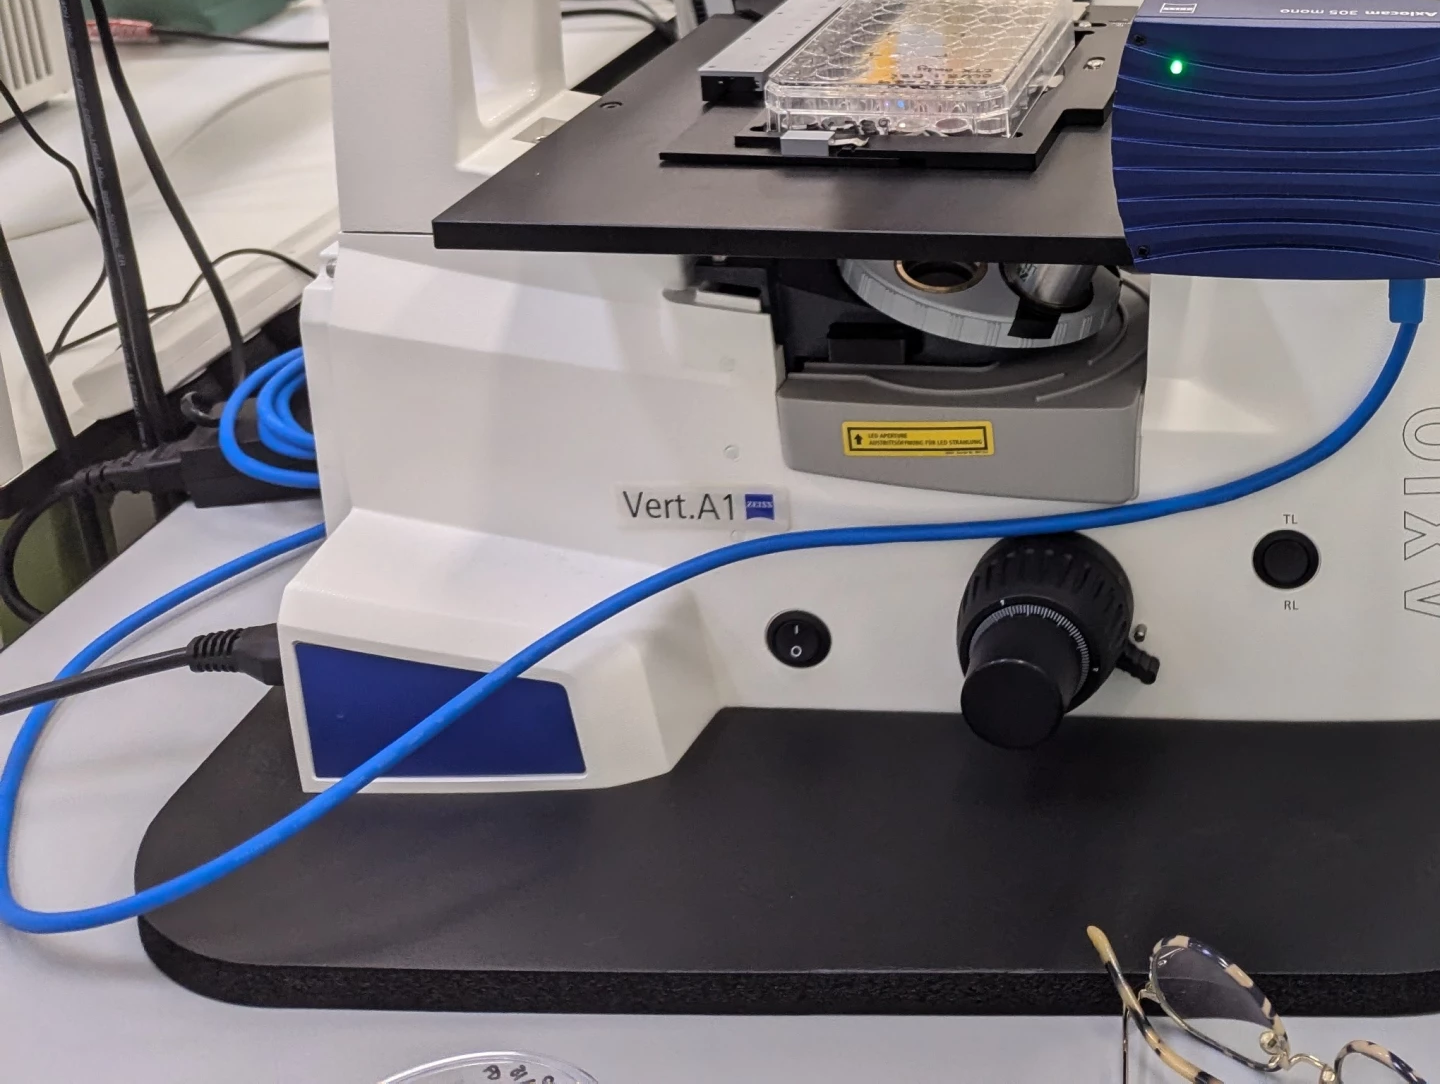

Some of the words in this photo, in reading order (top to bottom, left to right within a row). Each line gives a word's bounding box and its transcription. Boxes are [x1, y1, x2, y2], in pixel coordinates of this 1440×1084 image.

[622, 490, 734, 521] Vert.A1
[746, 500, 774, 509] ZEISS
[1283, 513, 1298, 525] TL
[1284, 600, 1299, 611] RL
